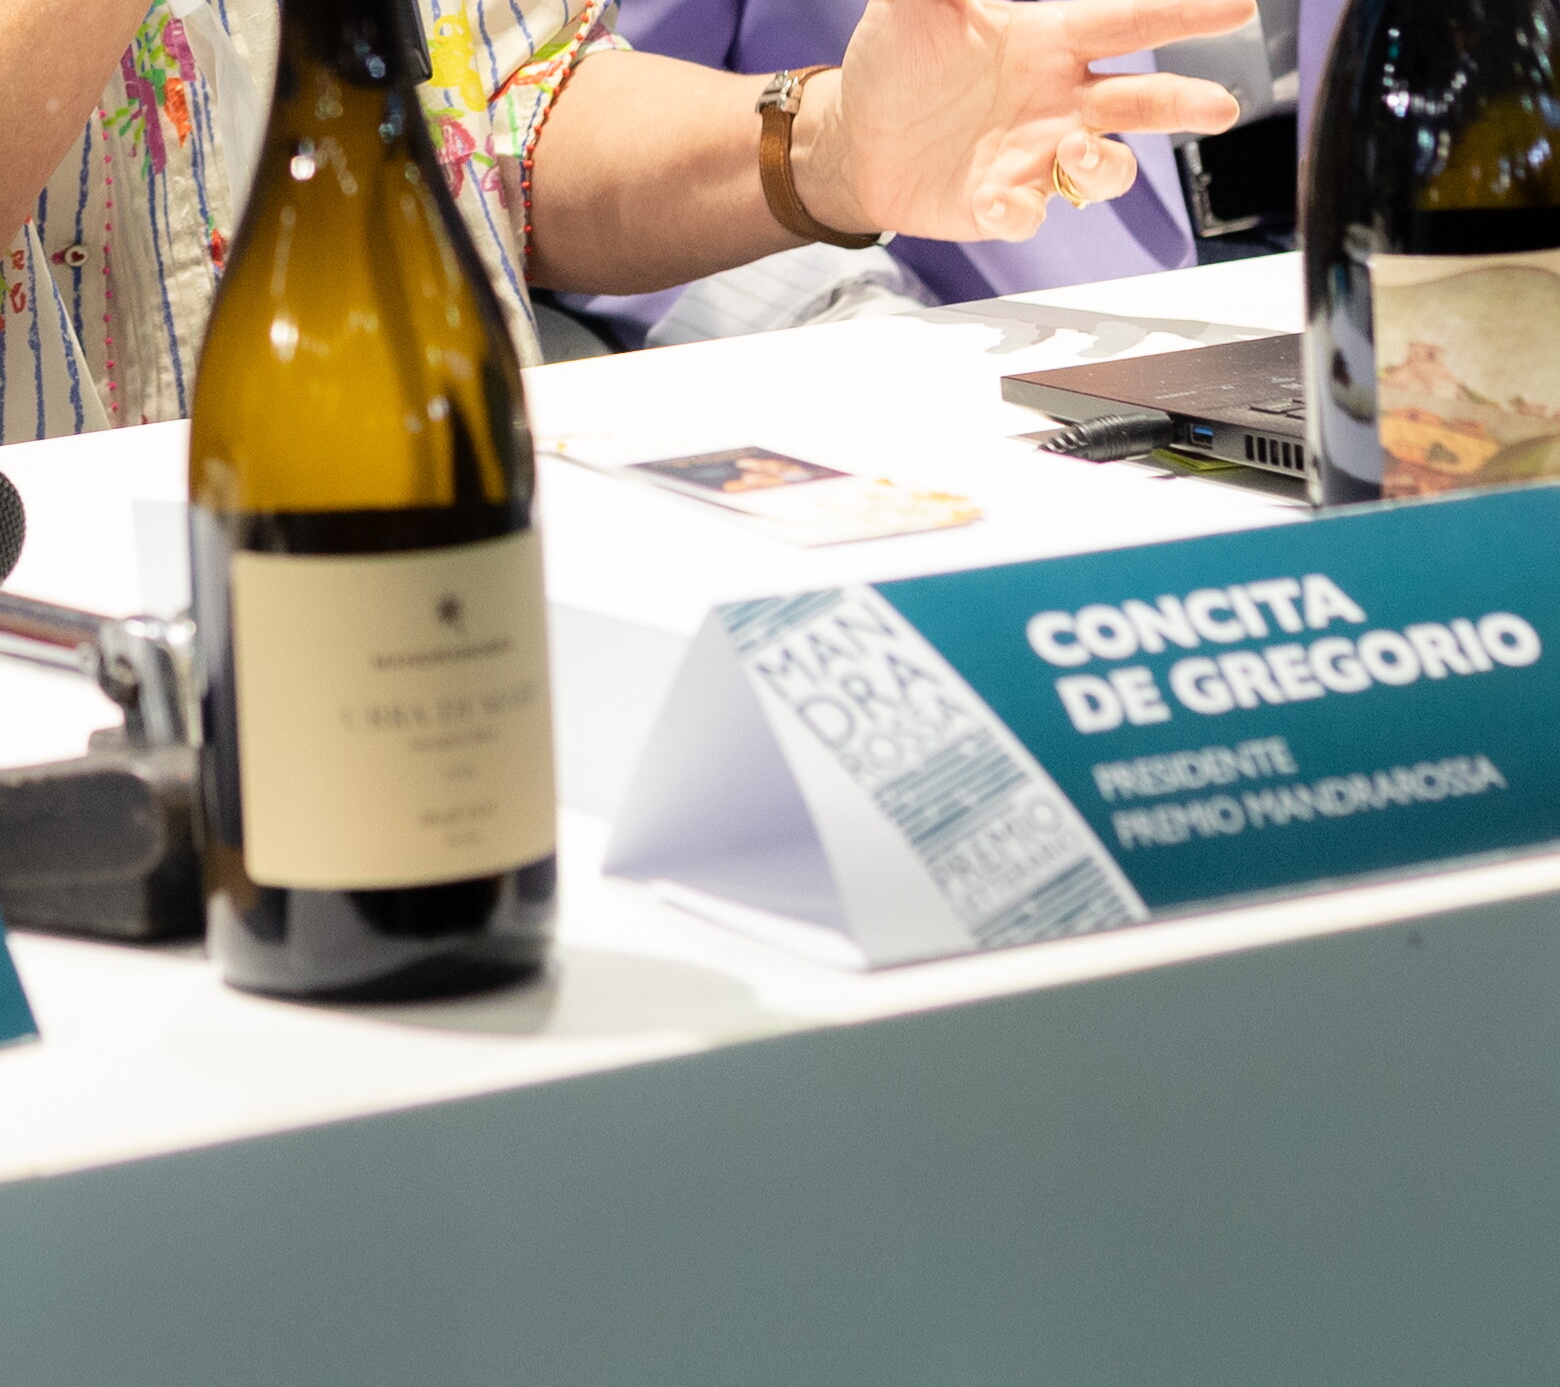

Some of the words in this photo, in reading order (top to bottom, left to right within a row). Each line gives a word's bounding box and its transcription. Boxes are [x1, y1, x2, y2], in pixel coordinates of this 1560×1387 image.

[754, 600, 897, 704] MAN
[1026, 573, 1368, 668] CONCITA
[796, 653, 939, 750] DRA
[1055, 666, 1172, 734] DE
[1169, 611, 1543, 716] GREGORIO
[1092, 735, 1299, 802] PRESIDENTE
[1110, 794, 1246, 851] PREMIO
[1244, 753, 1508, 829] MANDRAROSSA
